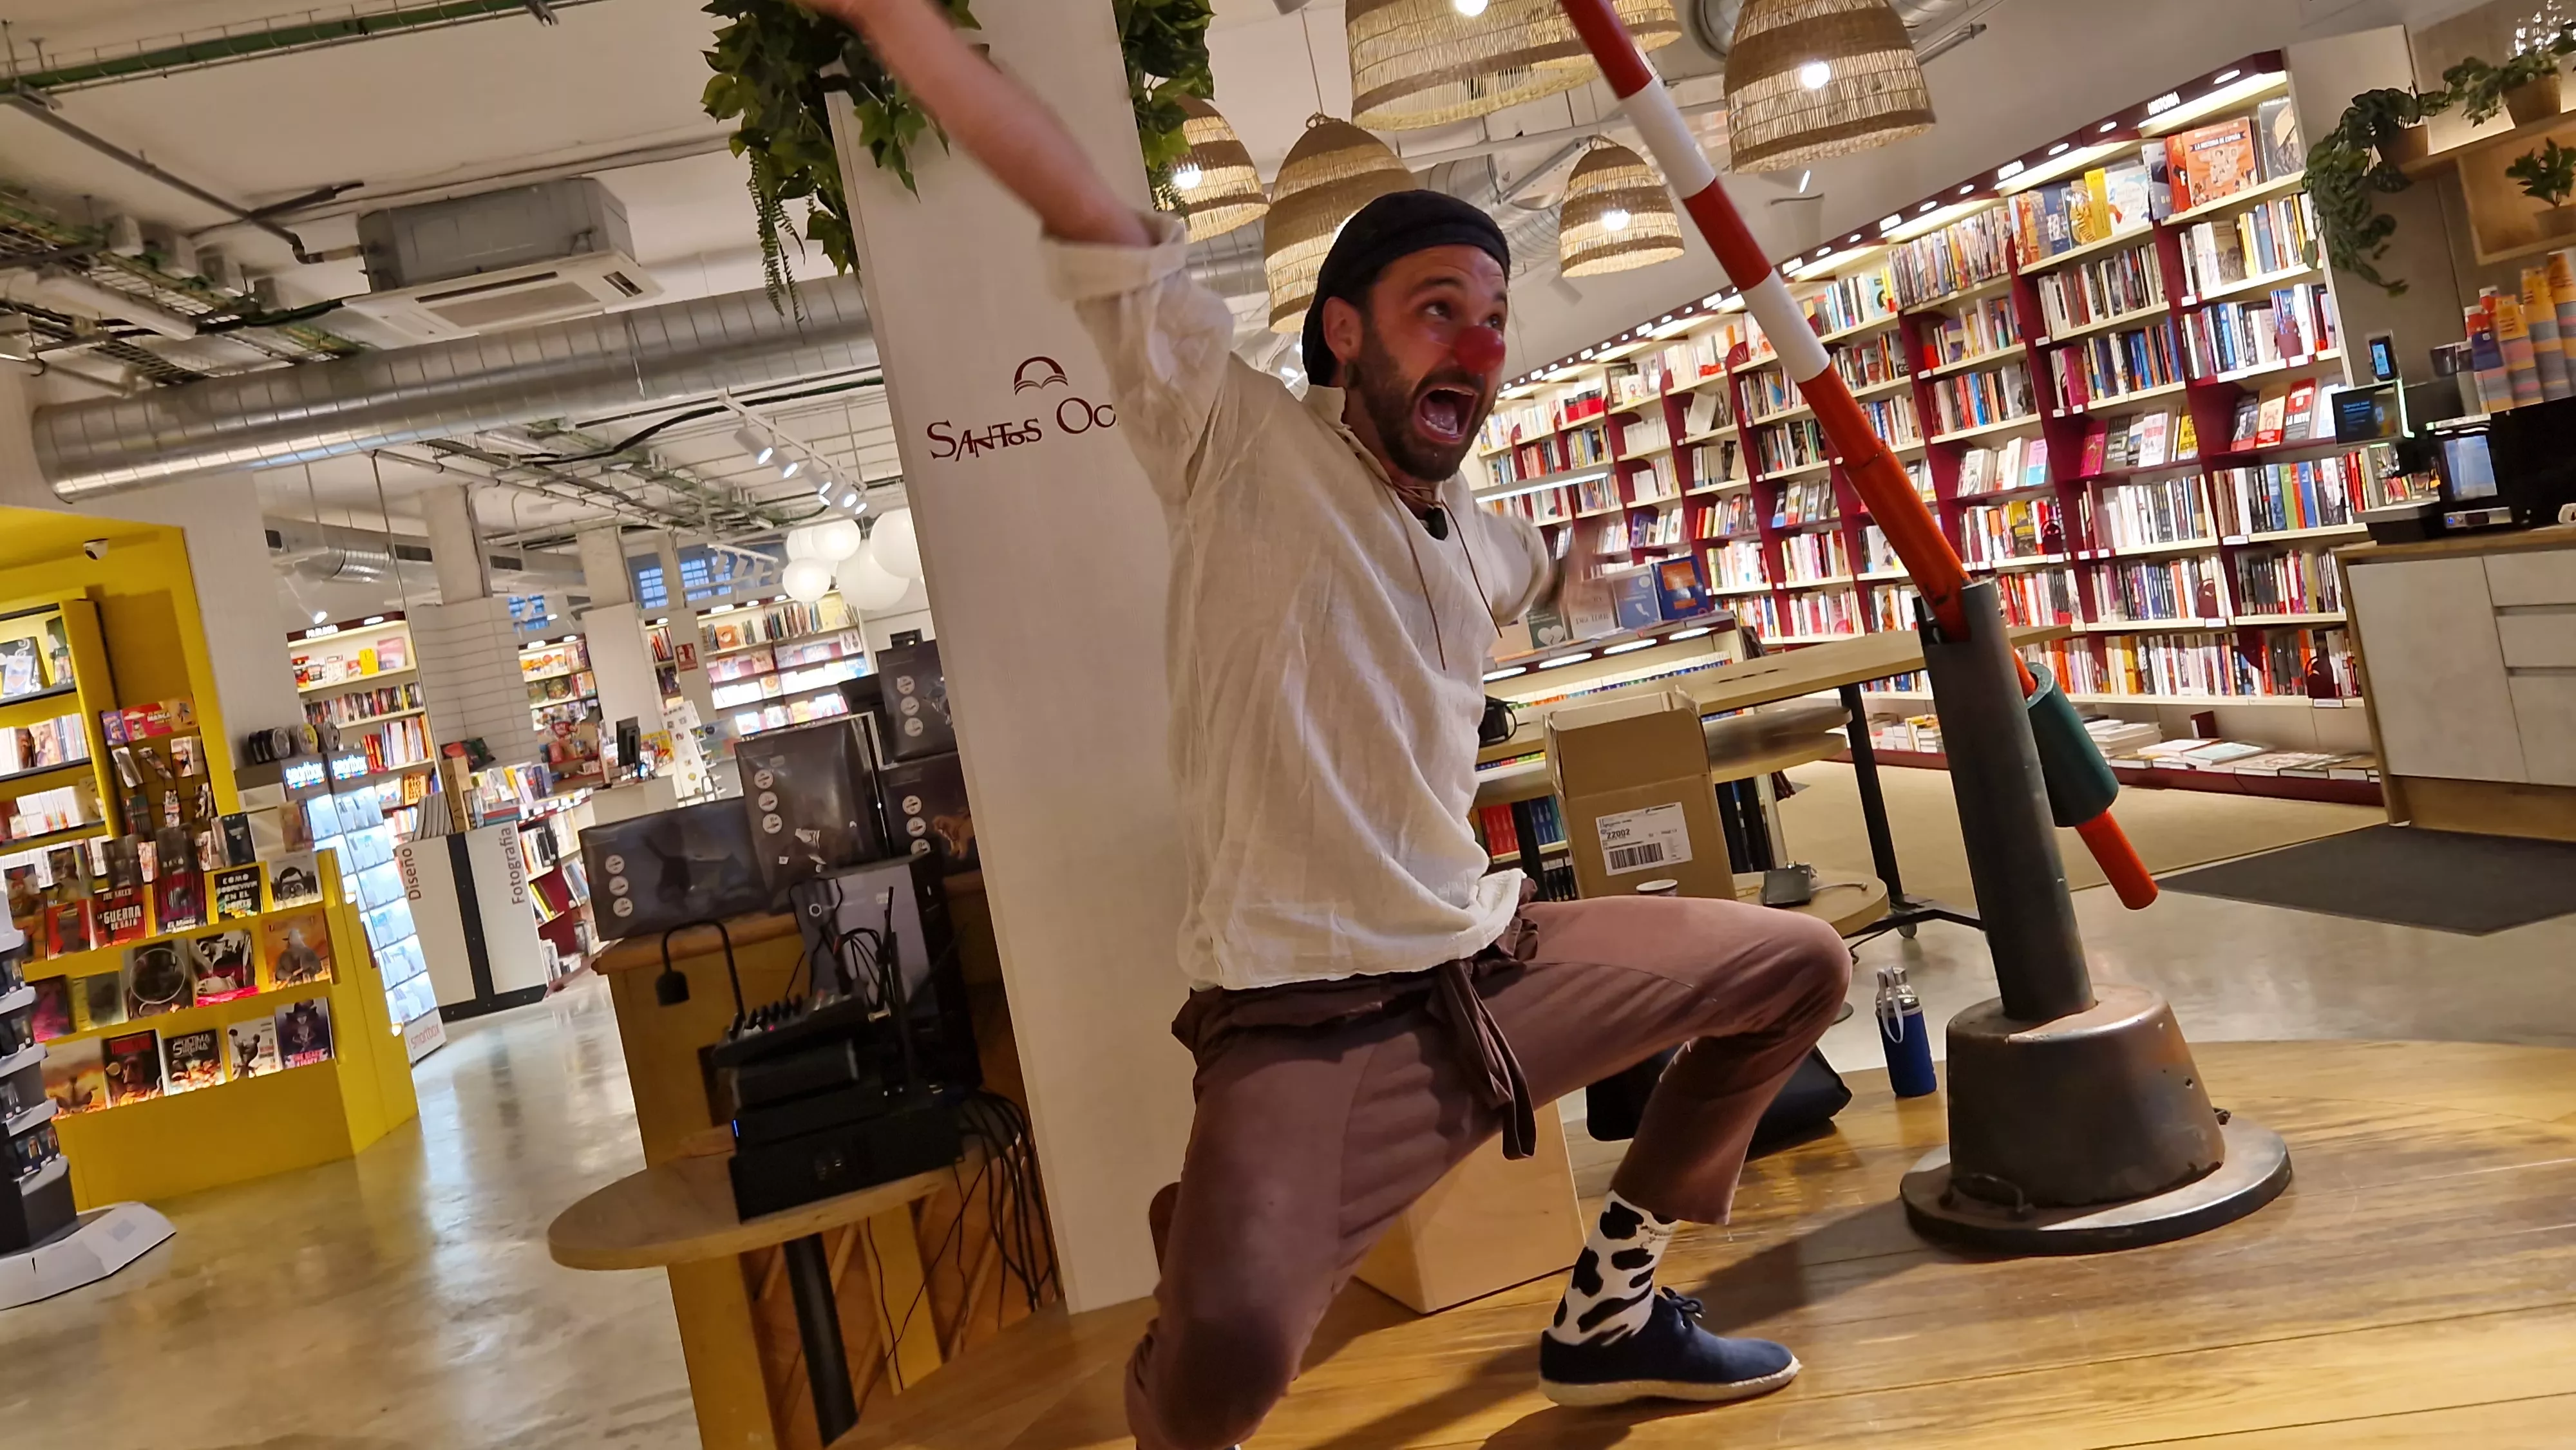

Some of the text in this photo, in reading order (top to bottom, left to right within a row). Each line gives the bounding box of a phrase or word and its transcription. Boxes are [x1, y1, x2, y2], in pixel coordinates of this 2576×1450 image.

[1056, 397, 1117, 435] OC
[1606, 828, 1631, 840] 22002
[402, 847, 422, 901] Diseño
[499, 827, 525, 905] Fotografía
[223, 873, 249, 885] COMO
[224, 890, 250, 902] EN EL
[104, 905, 142, 925] GUERRA
[410, 1022, 440, 1049] smartbox
